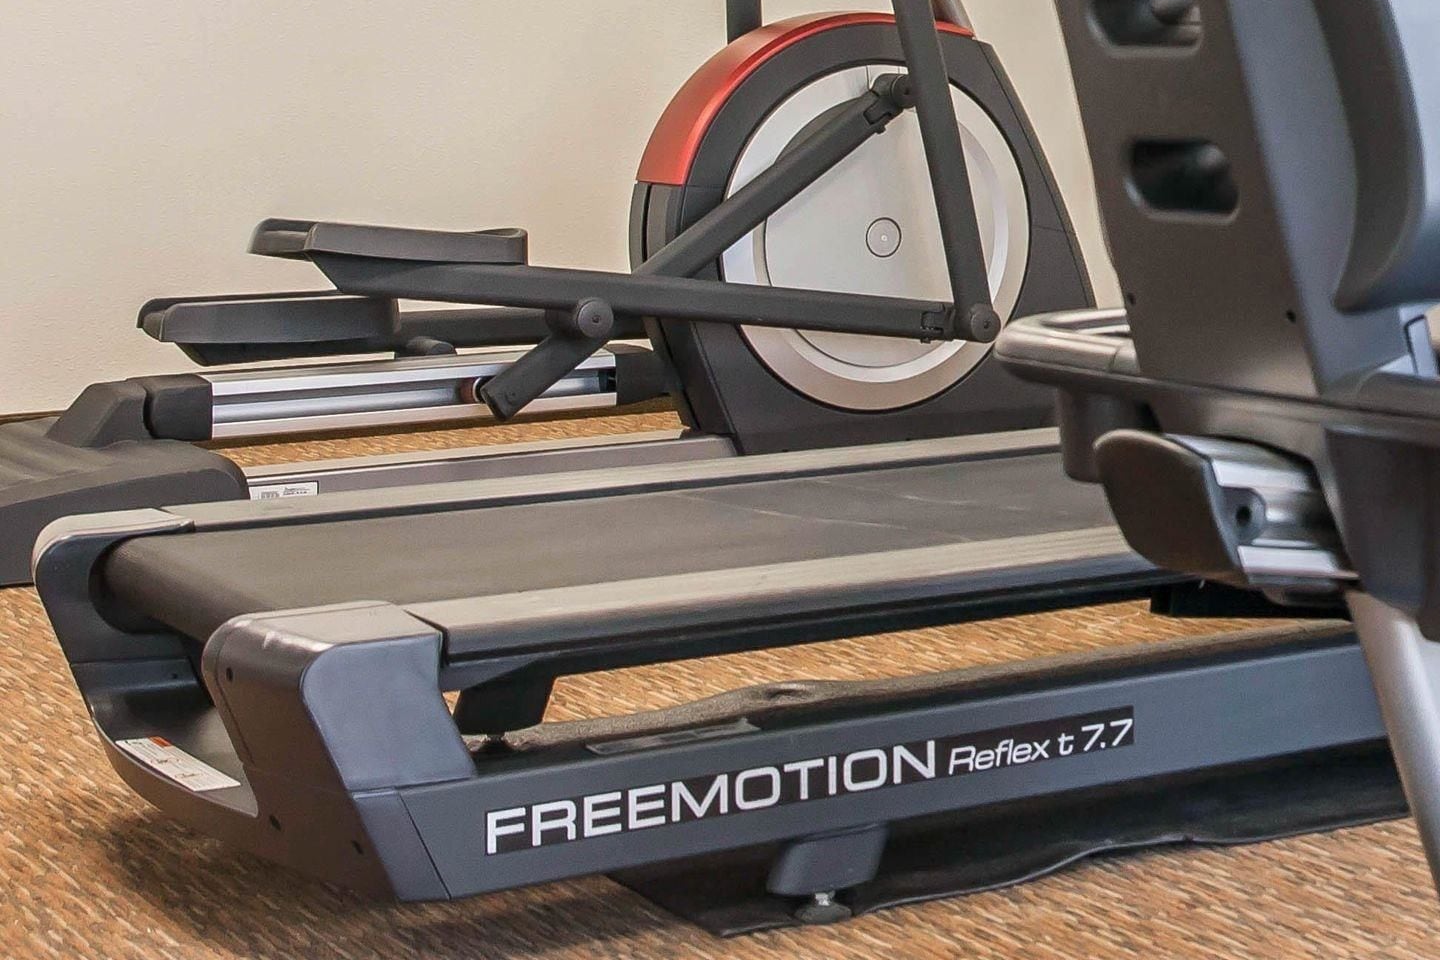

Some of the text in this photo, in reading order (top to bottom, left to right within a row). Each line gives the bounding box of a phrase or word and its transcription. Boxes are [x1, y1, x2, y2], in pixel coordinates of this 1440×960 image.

[486, 718, 1133, 854] FREEMOTION Reflex t 7.7
